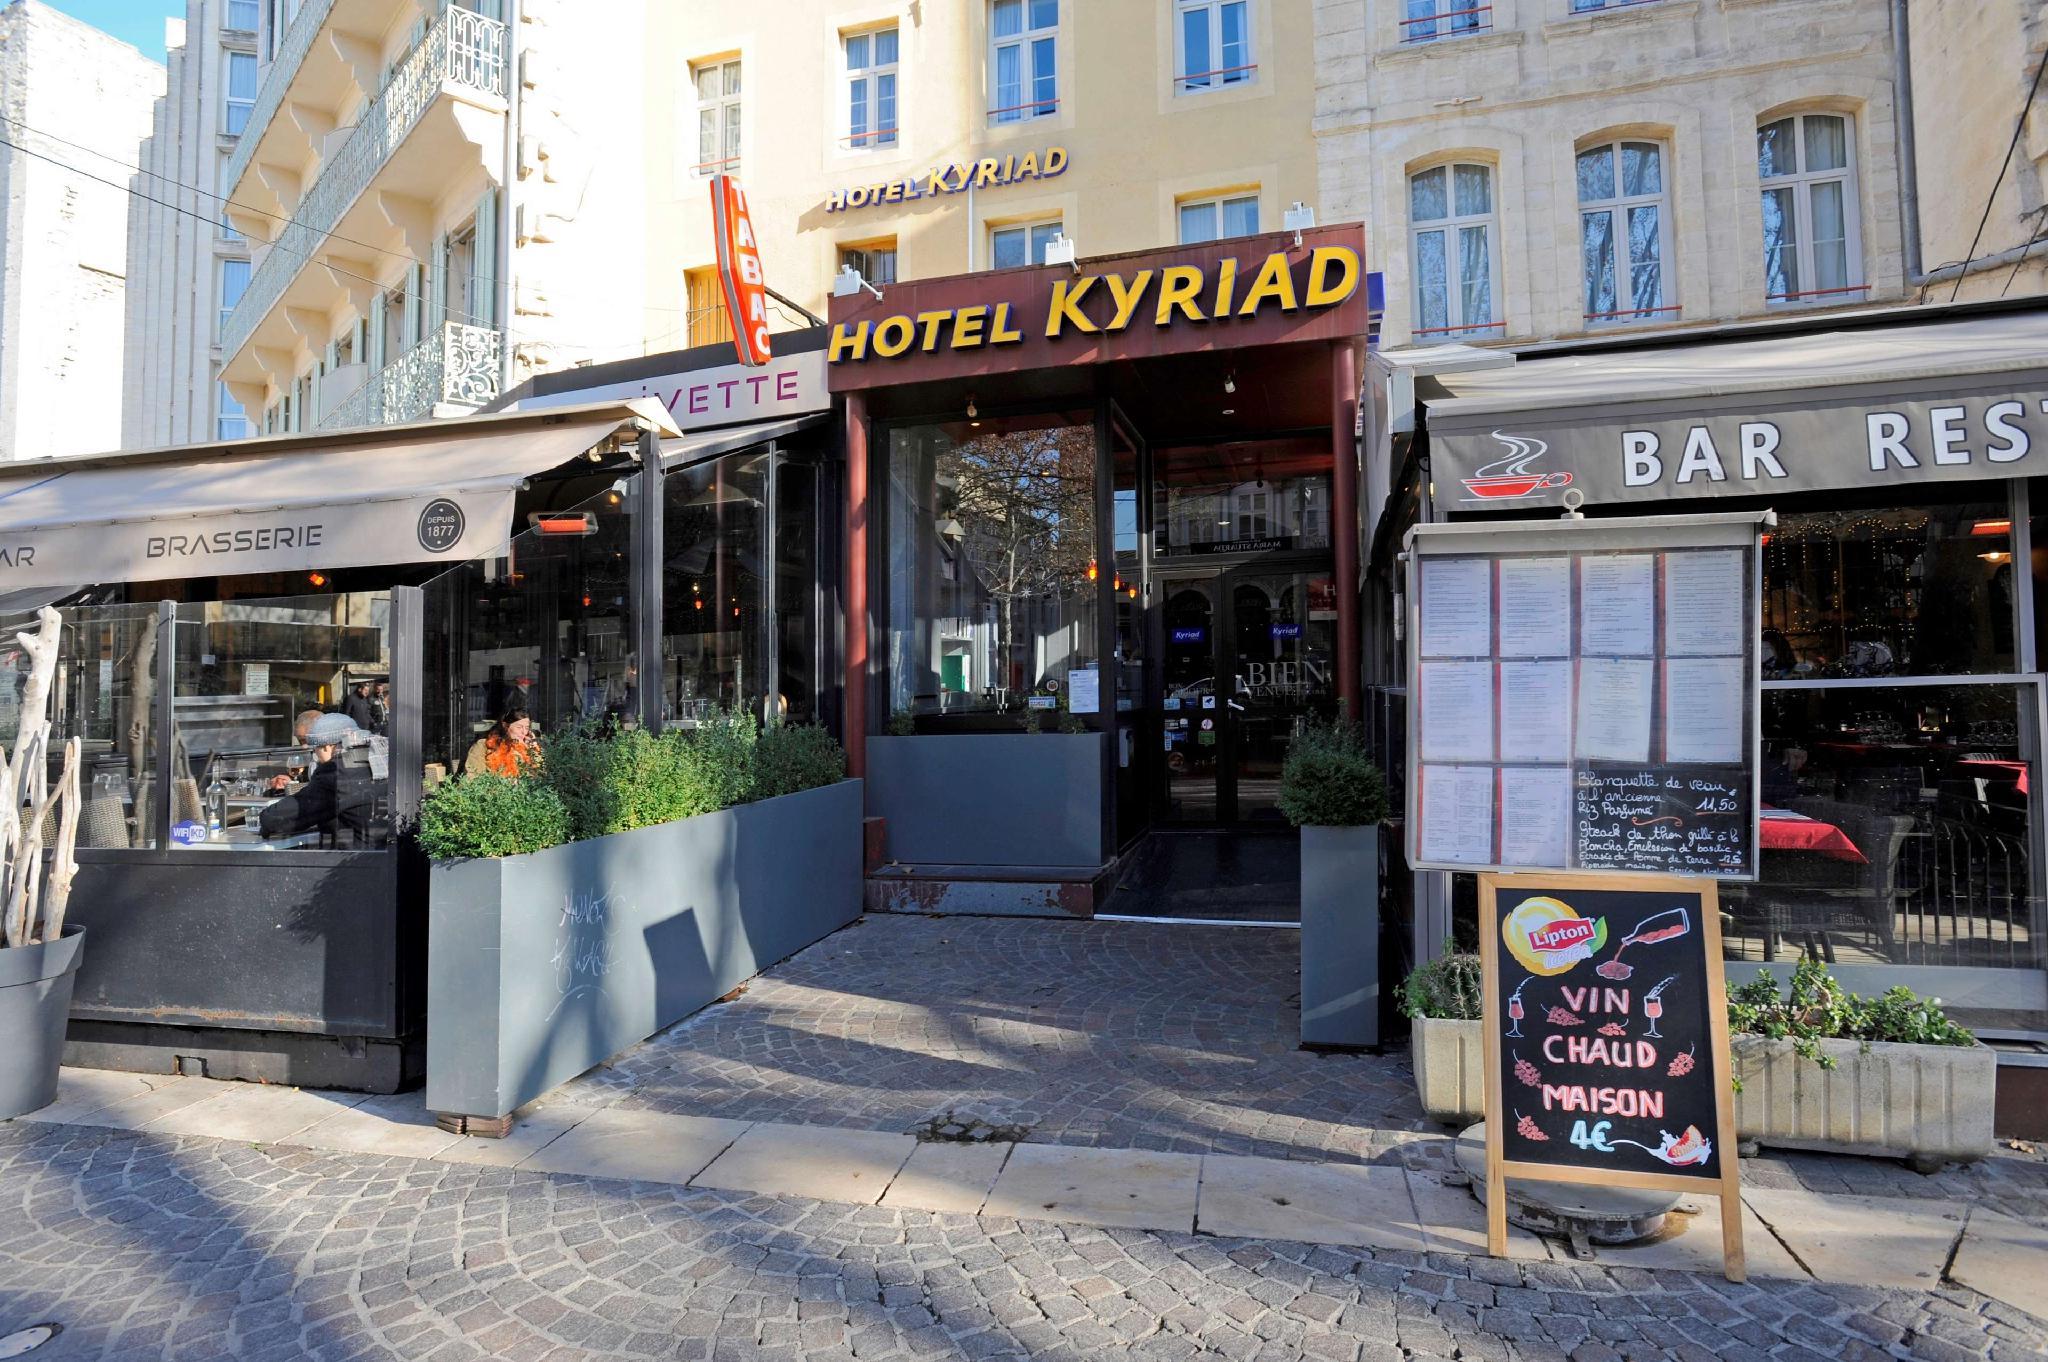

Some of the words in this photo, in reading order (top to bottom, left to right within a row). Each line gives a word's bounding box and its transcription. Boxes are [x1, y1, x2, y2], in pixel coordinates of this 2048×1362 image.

[824, 177, 921, 213] HOTEL
[927, 146, 1069, 197] KYRIAD
[731, 180, 771, 355] TABAC
[826, 301, 1024, 364] HOTEL
[1044, 244, 1362, 338] KYRIAD
[1620, 420, 1789, 488] BAR
[426, 525, 455, 538] 1877
[427, 515, 456, 525] DEPUIS
[146, 524, 323, 559] BRASSERIE
[1175, 630, 1201, 640] Kyriad
[1272, 626, 1299, 636] Kyriad
[1246, 659, 1328, 688] BIEN
[1578, 771, 1660, 796] Blanquette
[1665, 776, 1683, 789] de
[1689, 780, 1727, 792] veau
[1695, 797, 1738, 813] 11,50
[1627, 827, 1646, 840] de
[1649, 825, 1682, 840] thon
[1667, 854, 1682, 864] de
[1532, 925, 1590, 947] Lipton
[1561, 985, 1629, 1015] VIN
[1543, 1035, 1657, 1068] CHAUD
[1541, 1083, 1664, 1118] MAISON
[1569, 1120, 1615, 1152] 4€
